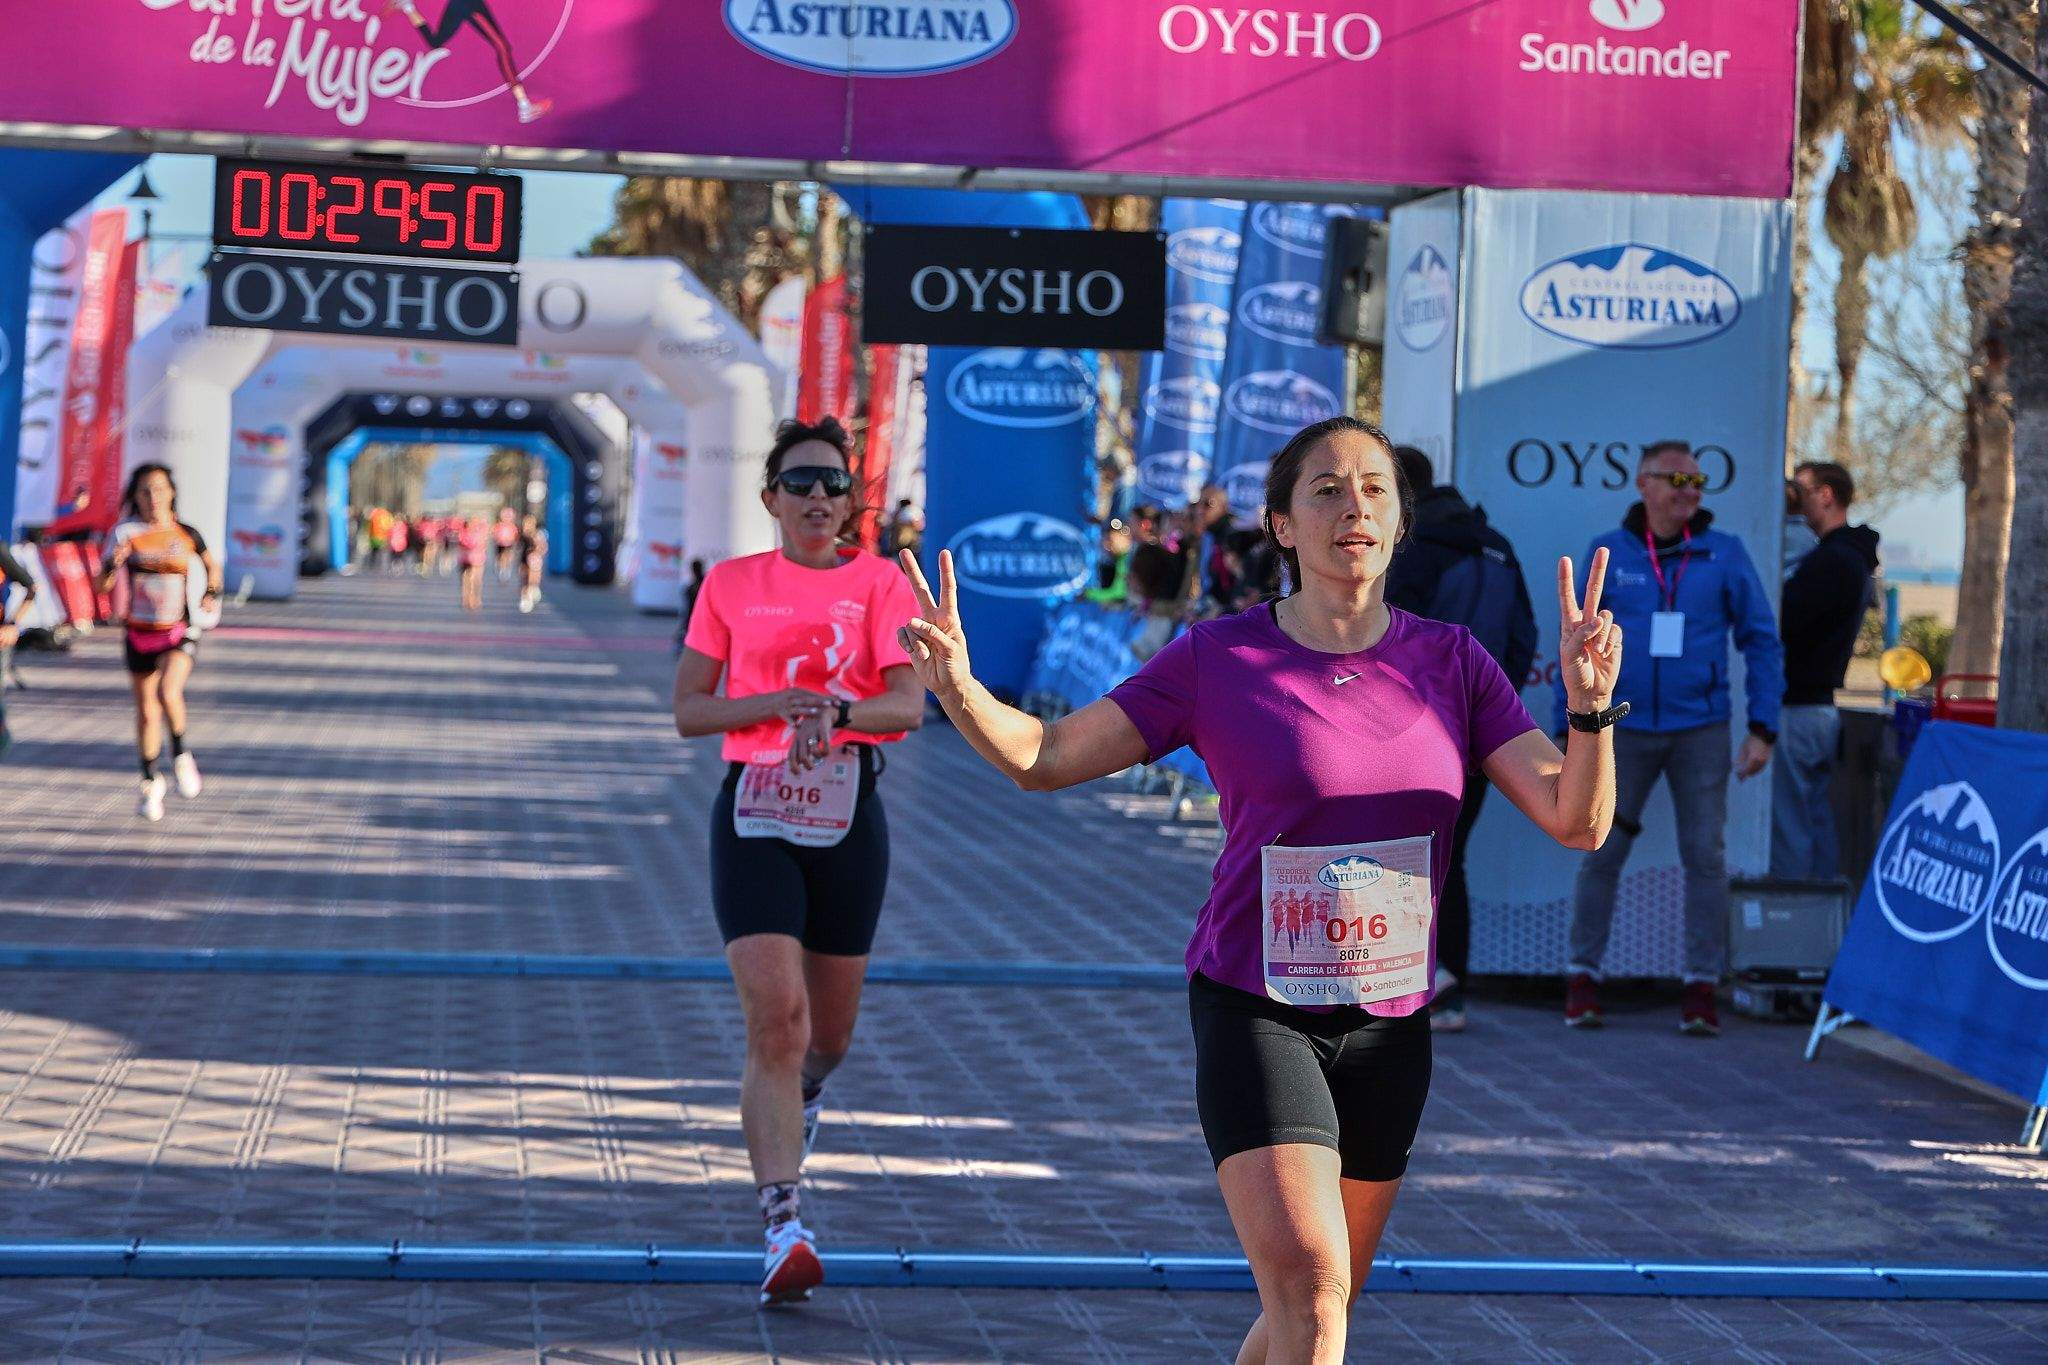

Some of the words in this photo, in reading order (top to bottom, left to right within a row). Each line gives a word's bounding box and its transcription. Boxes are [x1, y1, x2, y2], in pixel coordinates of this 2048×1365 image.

[189, 14, 236, 63] de
[242, 16, 276, 66] la
[749, 0, 993, 42] ASTURIANA
[1158, 4, 1382, 61] OYSHO
[264, 15, 451, 126] Mujer
[1519, 33, 1731, 79] Santander
[231, 170, 504, 252] 00:29:50
[222, 262, 508, 335] OYSHO
[910, 265, 1124, 317] OYSHO
[1537, 281, 1722, 324] ASTURIANA
[1508, 439, 1737, 494] OYSO
[779, 785, 821, 804] 016
[1277, 875, 1311, 885] SUMA
[1323, 870, 1380, 884] ASTURIANA
[1882, 825, 1984, 915] ASTURIANA
[1326, 913, 1388, 943] 016
[1288, 966, 1324, 975] CARRERA
[1326, 966, 1337, 974] DE
[1340, 966, 1349, 974] LA
[1352, 963, 1377, 973] MUJER
[1382, 957, 1412, 969] VALENCIA
[1339, 949, 1369, 961] 8078
[1285, 983, 1340, 995] OYSHO
[1373, 976, 1413, 991] Santander
